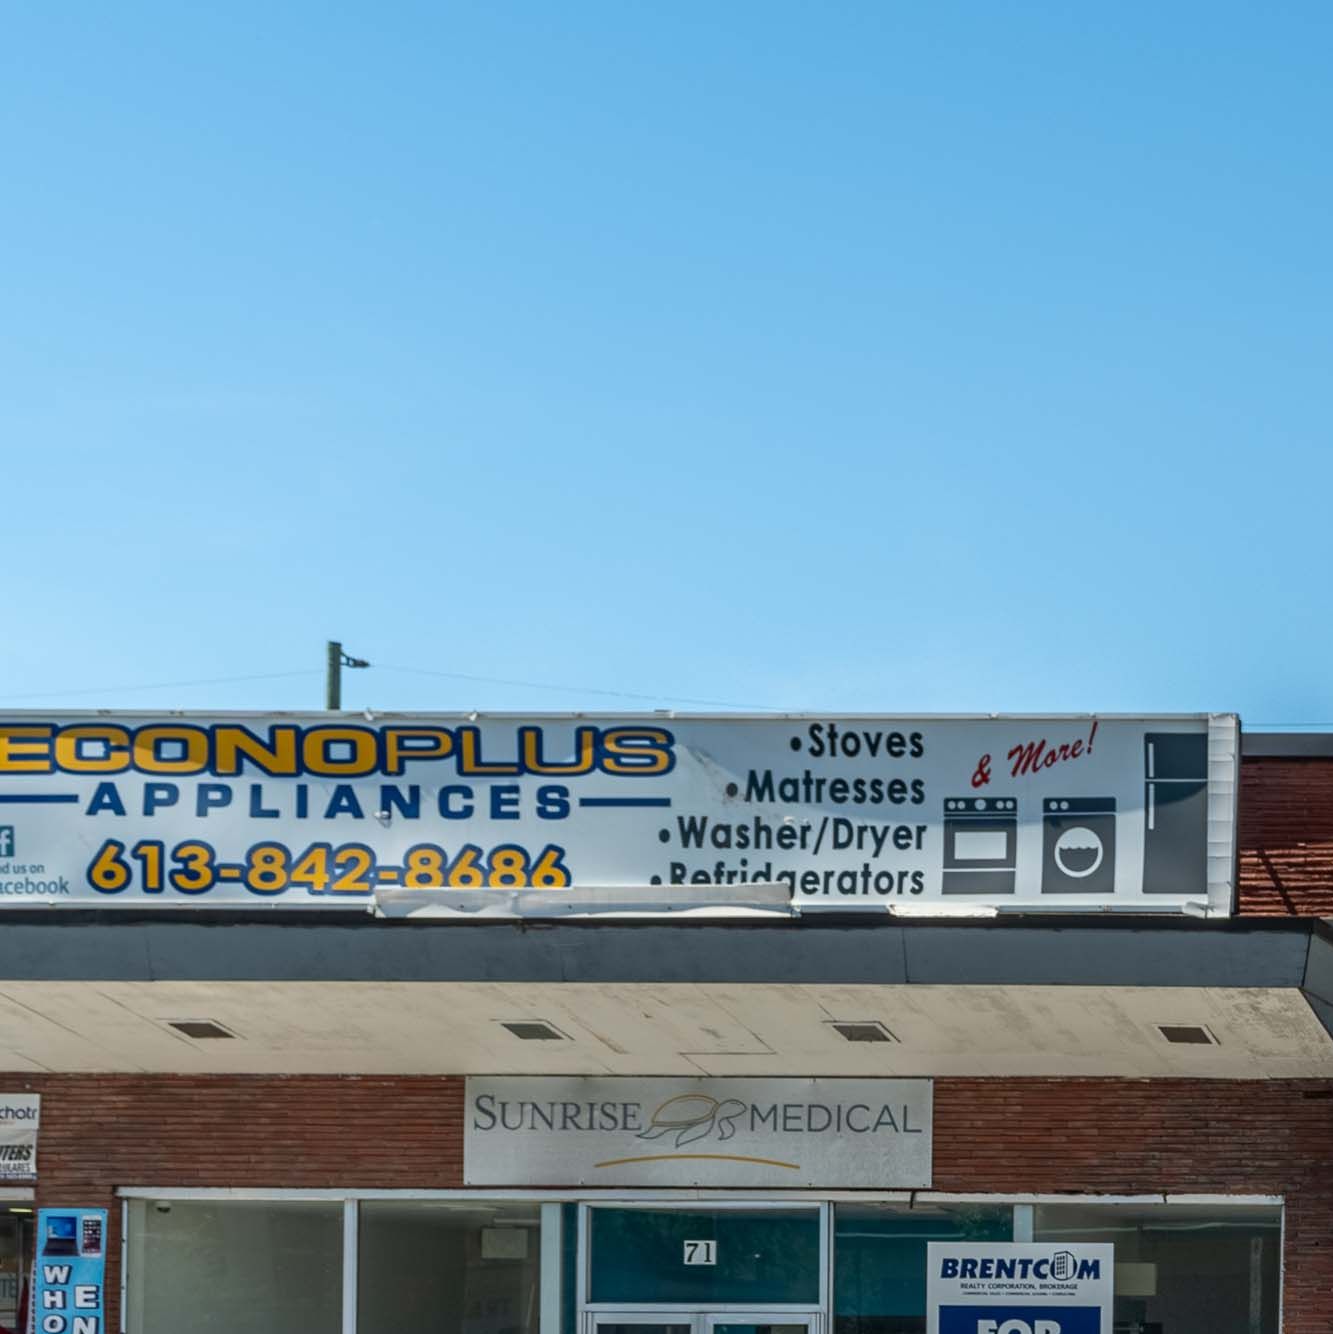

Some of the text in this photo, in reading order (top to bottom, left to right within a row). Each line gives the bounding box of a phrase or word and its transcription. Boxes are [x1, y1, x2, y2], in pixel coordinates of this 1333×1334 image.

[0, 723, 675, 778] ECONOPLUS
[808, 722, 925, 758] Stoves
[970, 721, 1099, 789] & More!
[85, 781, 571, 820] APPLIANCES
[745, 770, 925, 805] Matresses
[678, 815, 927, 858] Washer/Dryer
[12, 864, 27, 874] us
[29, 864, 45, 874] on
[86, 838, 572, 896] 613-842-8686
[473, 1094, 923, 1134] SUNRISE MEDICAL
[685, 1242, 714, 1264] 71
[940, 1250, 1101, 1281] BRENTCOM
